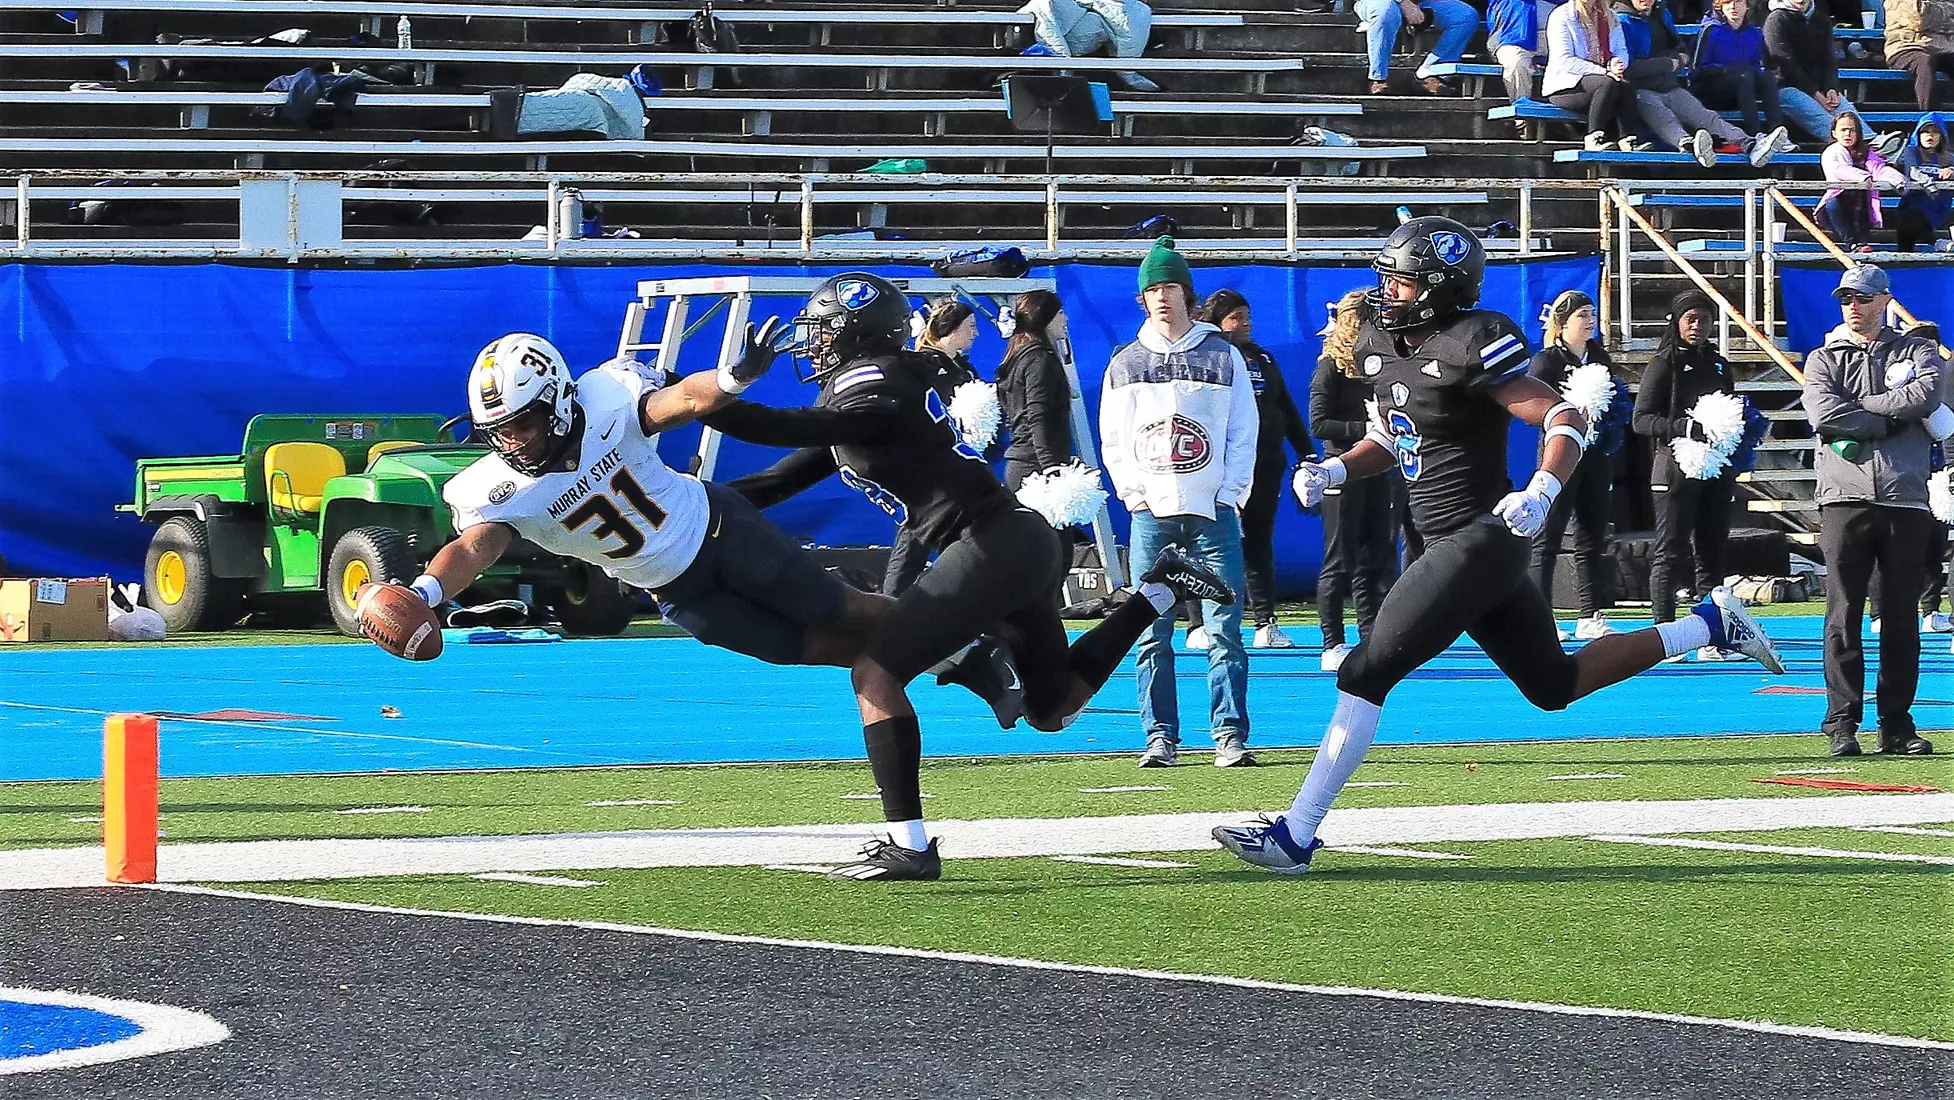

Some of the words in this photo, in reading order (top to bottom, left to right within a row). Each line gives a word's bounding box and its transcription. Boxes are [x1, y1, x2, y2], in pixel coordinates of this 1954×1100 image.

[521, 346, 552, 377] 31
[491, 481, 512, 500] OVC
[546, 476, 592, 519] MURRAY
[589, 448, 623, 482] STATE
[560, 464, 669, 560] 31
[1728, 611, 1756, 639] adidas
